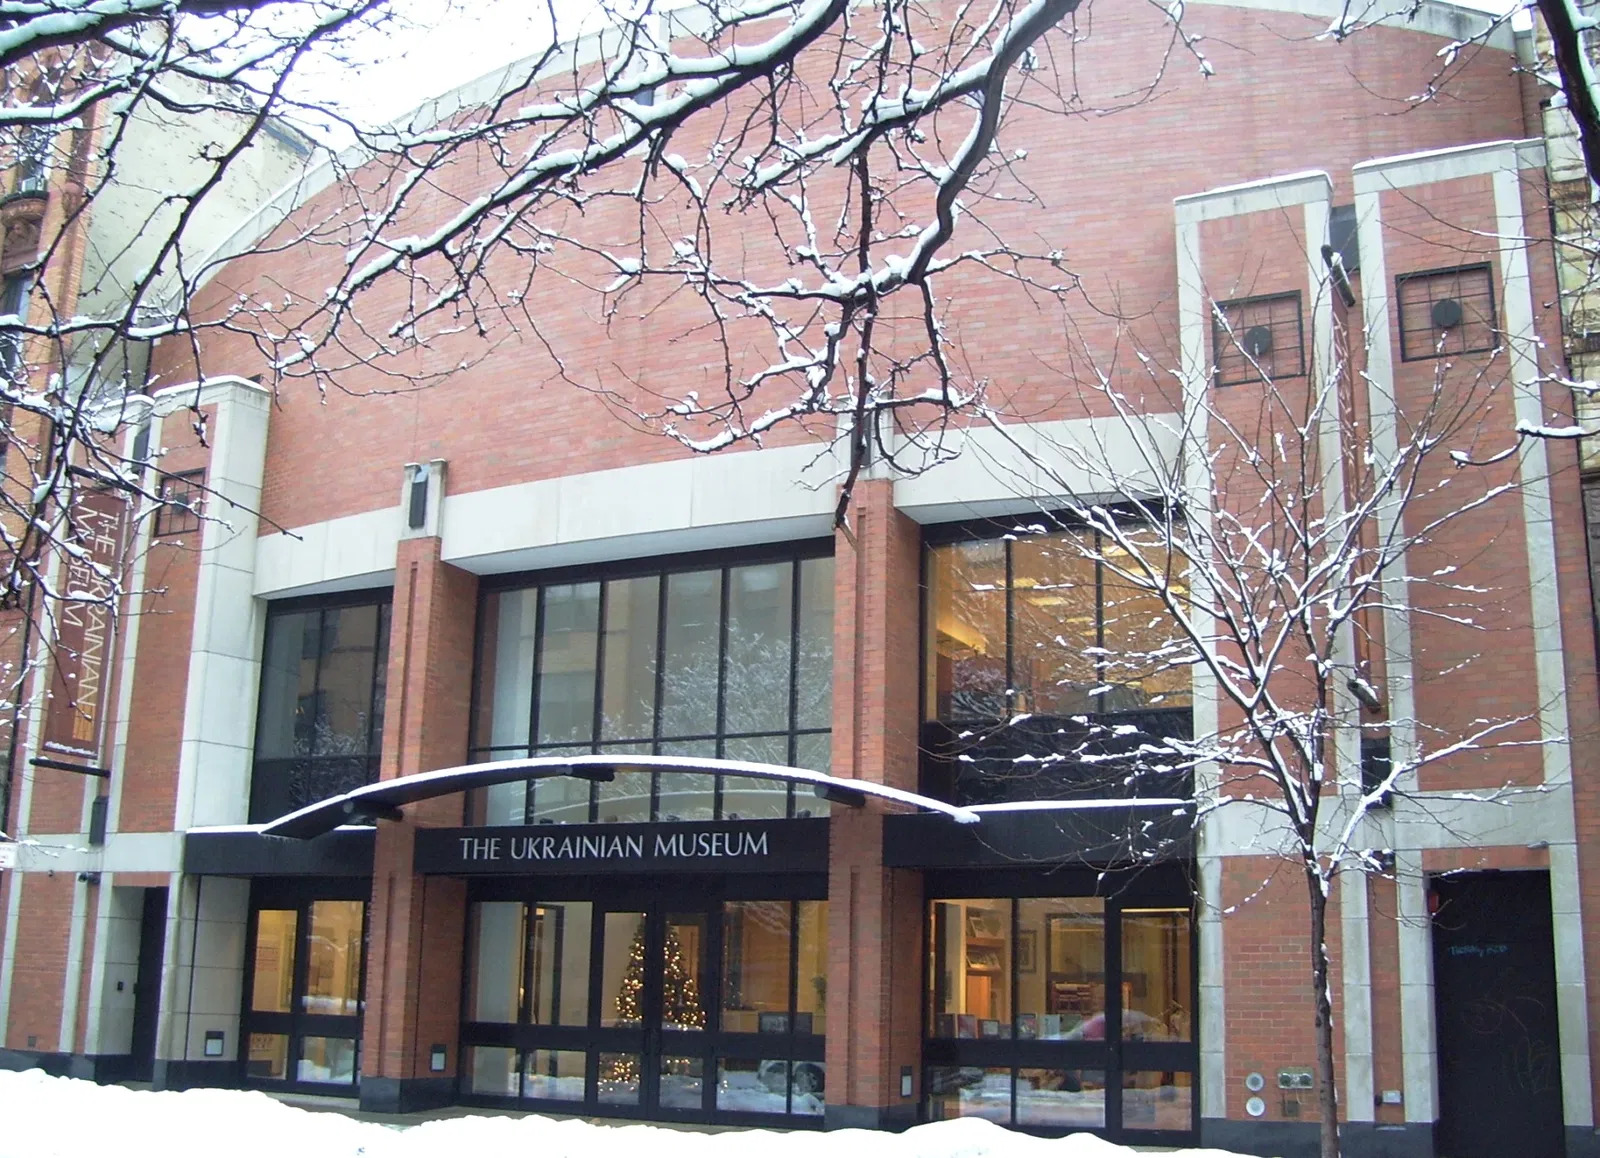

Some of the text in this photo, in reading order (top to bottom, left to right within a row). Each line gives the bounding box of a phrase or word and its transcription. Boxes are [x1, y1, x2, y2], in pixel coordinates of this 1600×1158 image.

[97, 512, 120, 557] THE
[460, 831, 768, 860] THE UKRAINIAN MUSEUM
